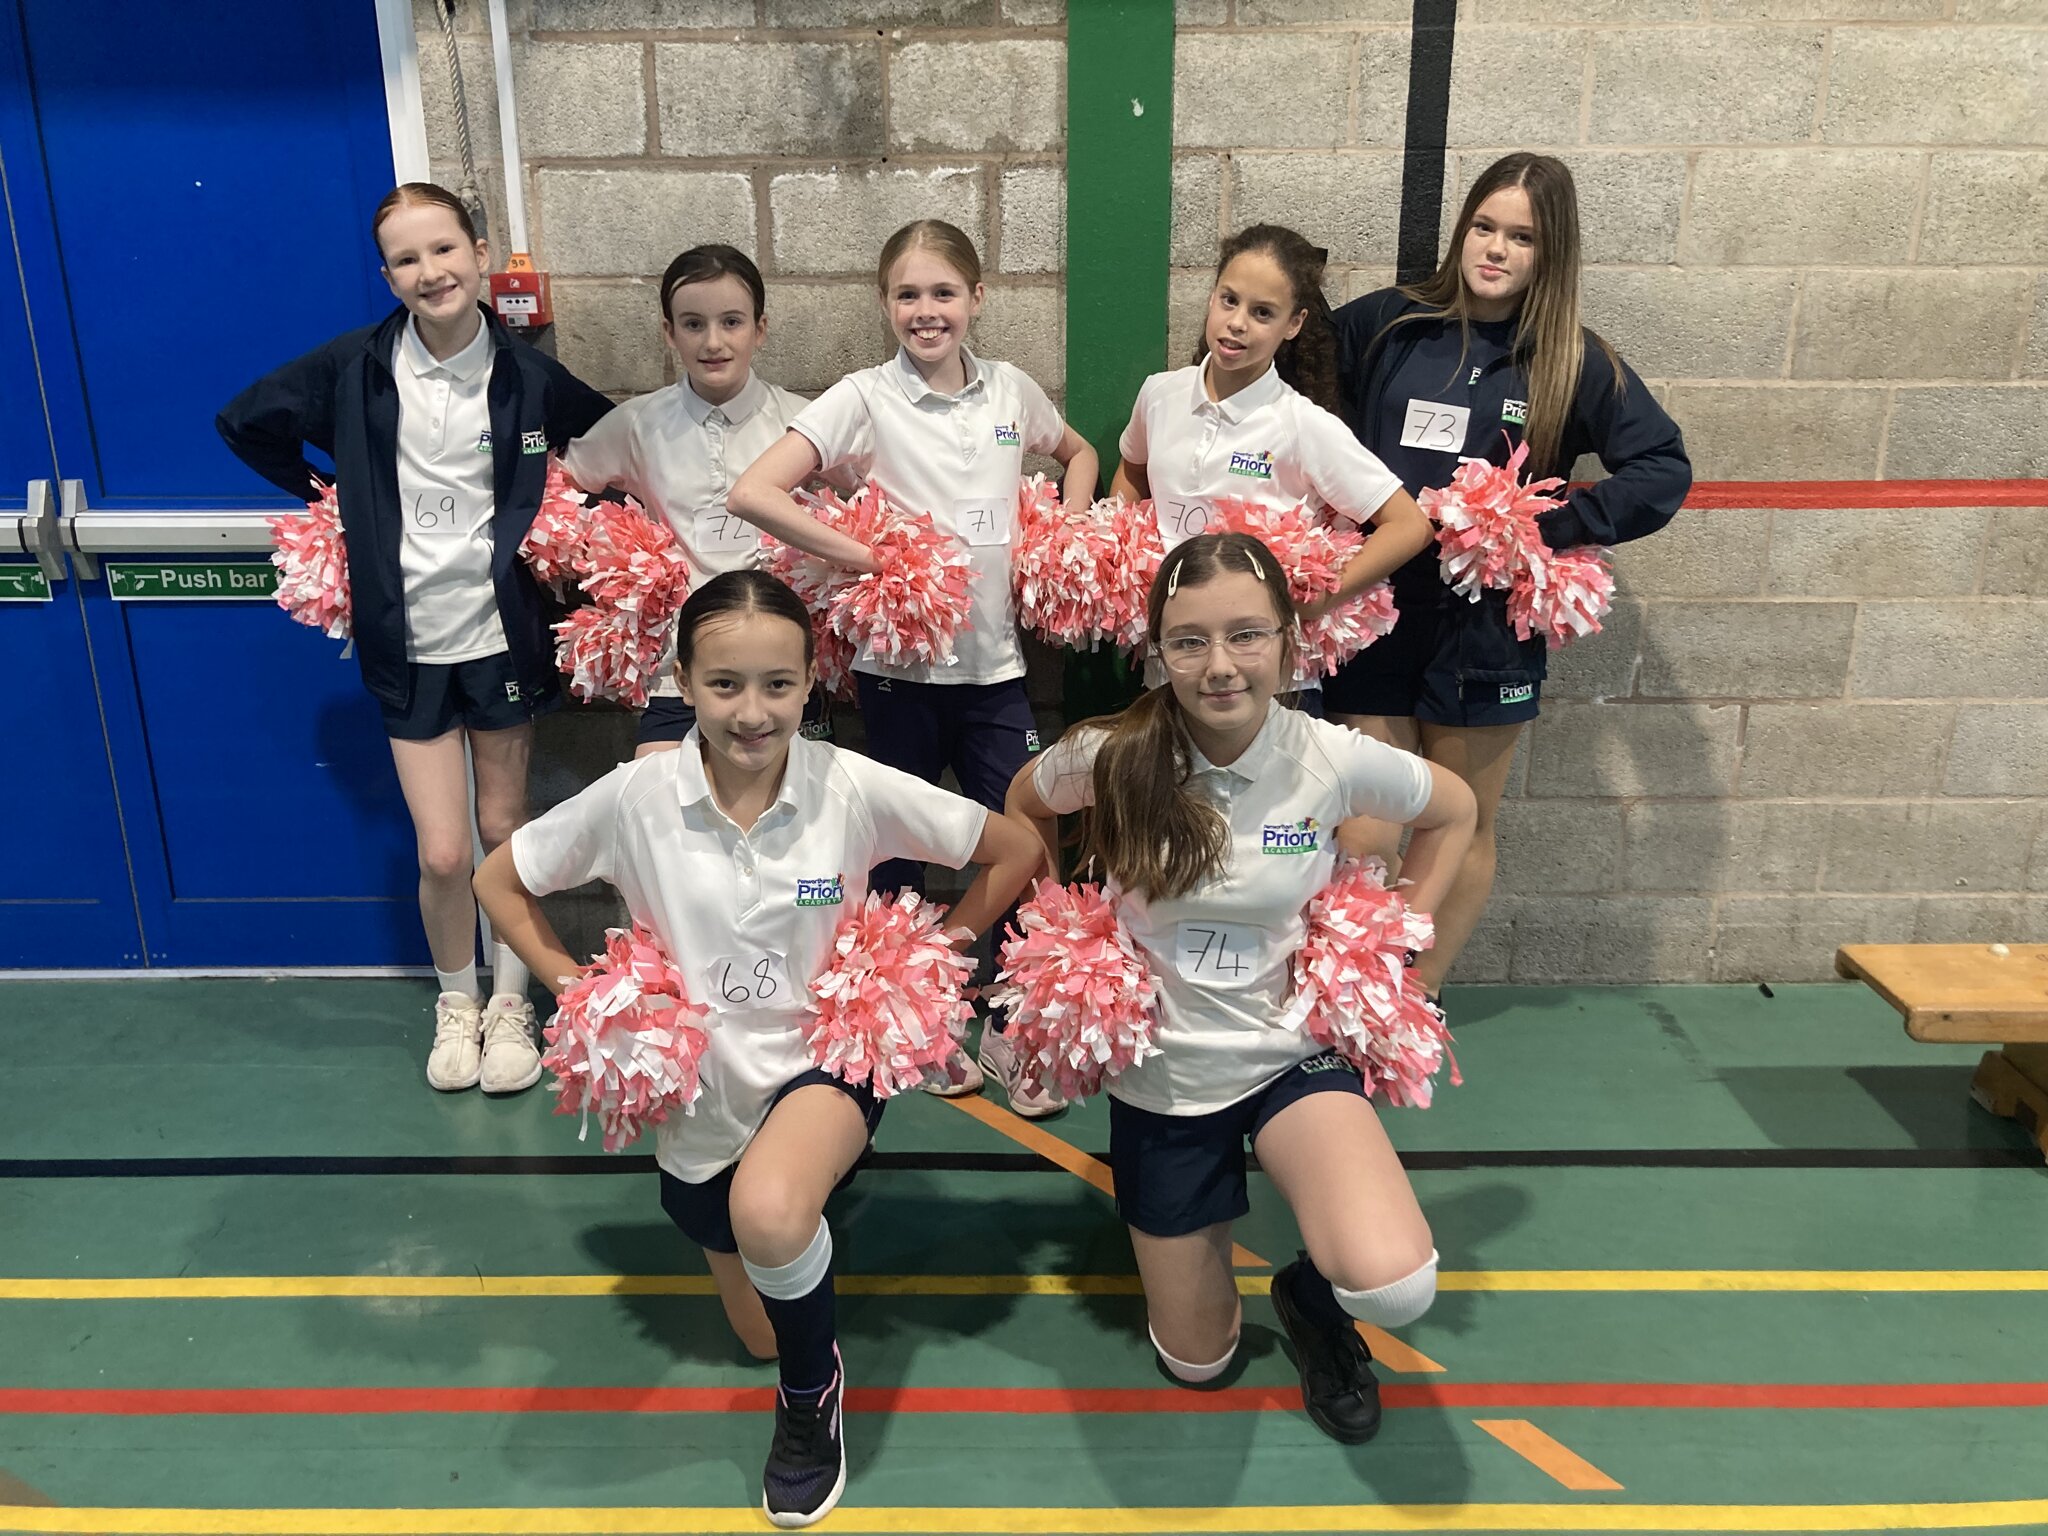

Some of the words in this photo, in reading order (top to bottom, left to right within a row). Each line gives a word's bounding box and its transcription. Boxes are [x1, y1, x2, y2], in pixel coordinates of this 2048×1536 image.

[1502, 402, 1527, 419] Prio
[1413, 409, 1456, 448] 73
[522, 434, 545, 448] Prio
[1230, 455, 1272, 476] Priory
[415, 493, 455, 528] 69
[967, 510, 994, 532] 71
[1168, 501, 1208, 536] 70
[707, 514, 751, 541] 72
[160, 569, 222, 588] Push
[229, 569, 268, 588] bar
[1263, 829, 1317, 847] Priory
[798, 884, 844, 901] Priory
[1187, 928, 1249, 977] 74
[722, 958, 777, 1003] 68
